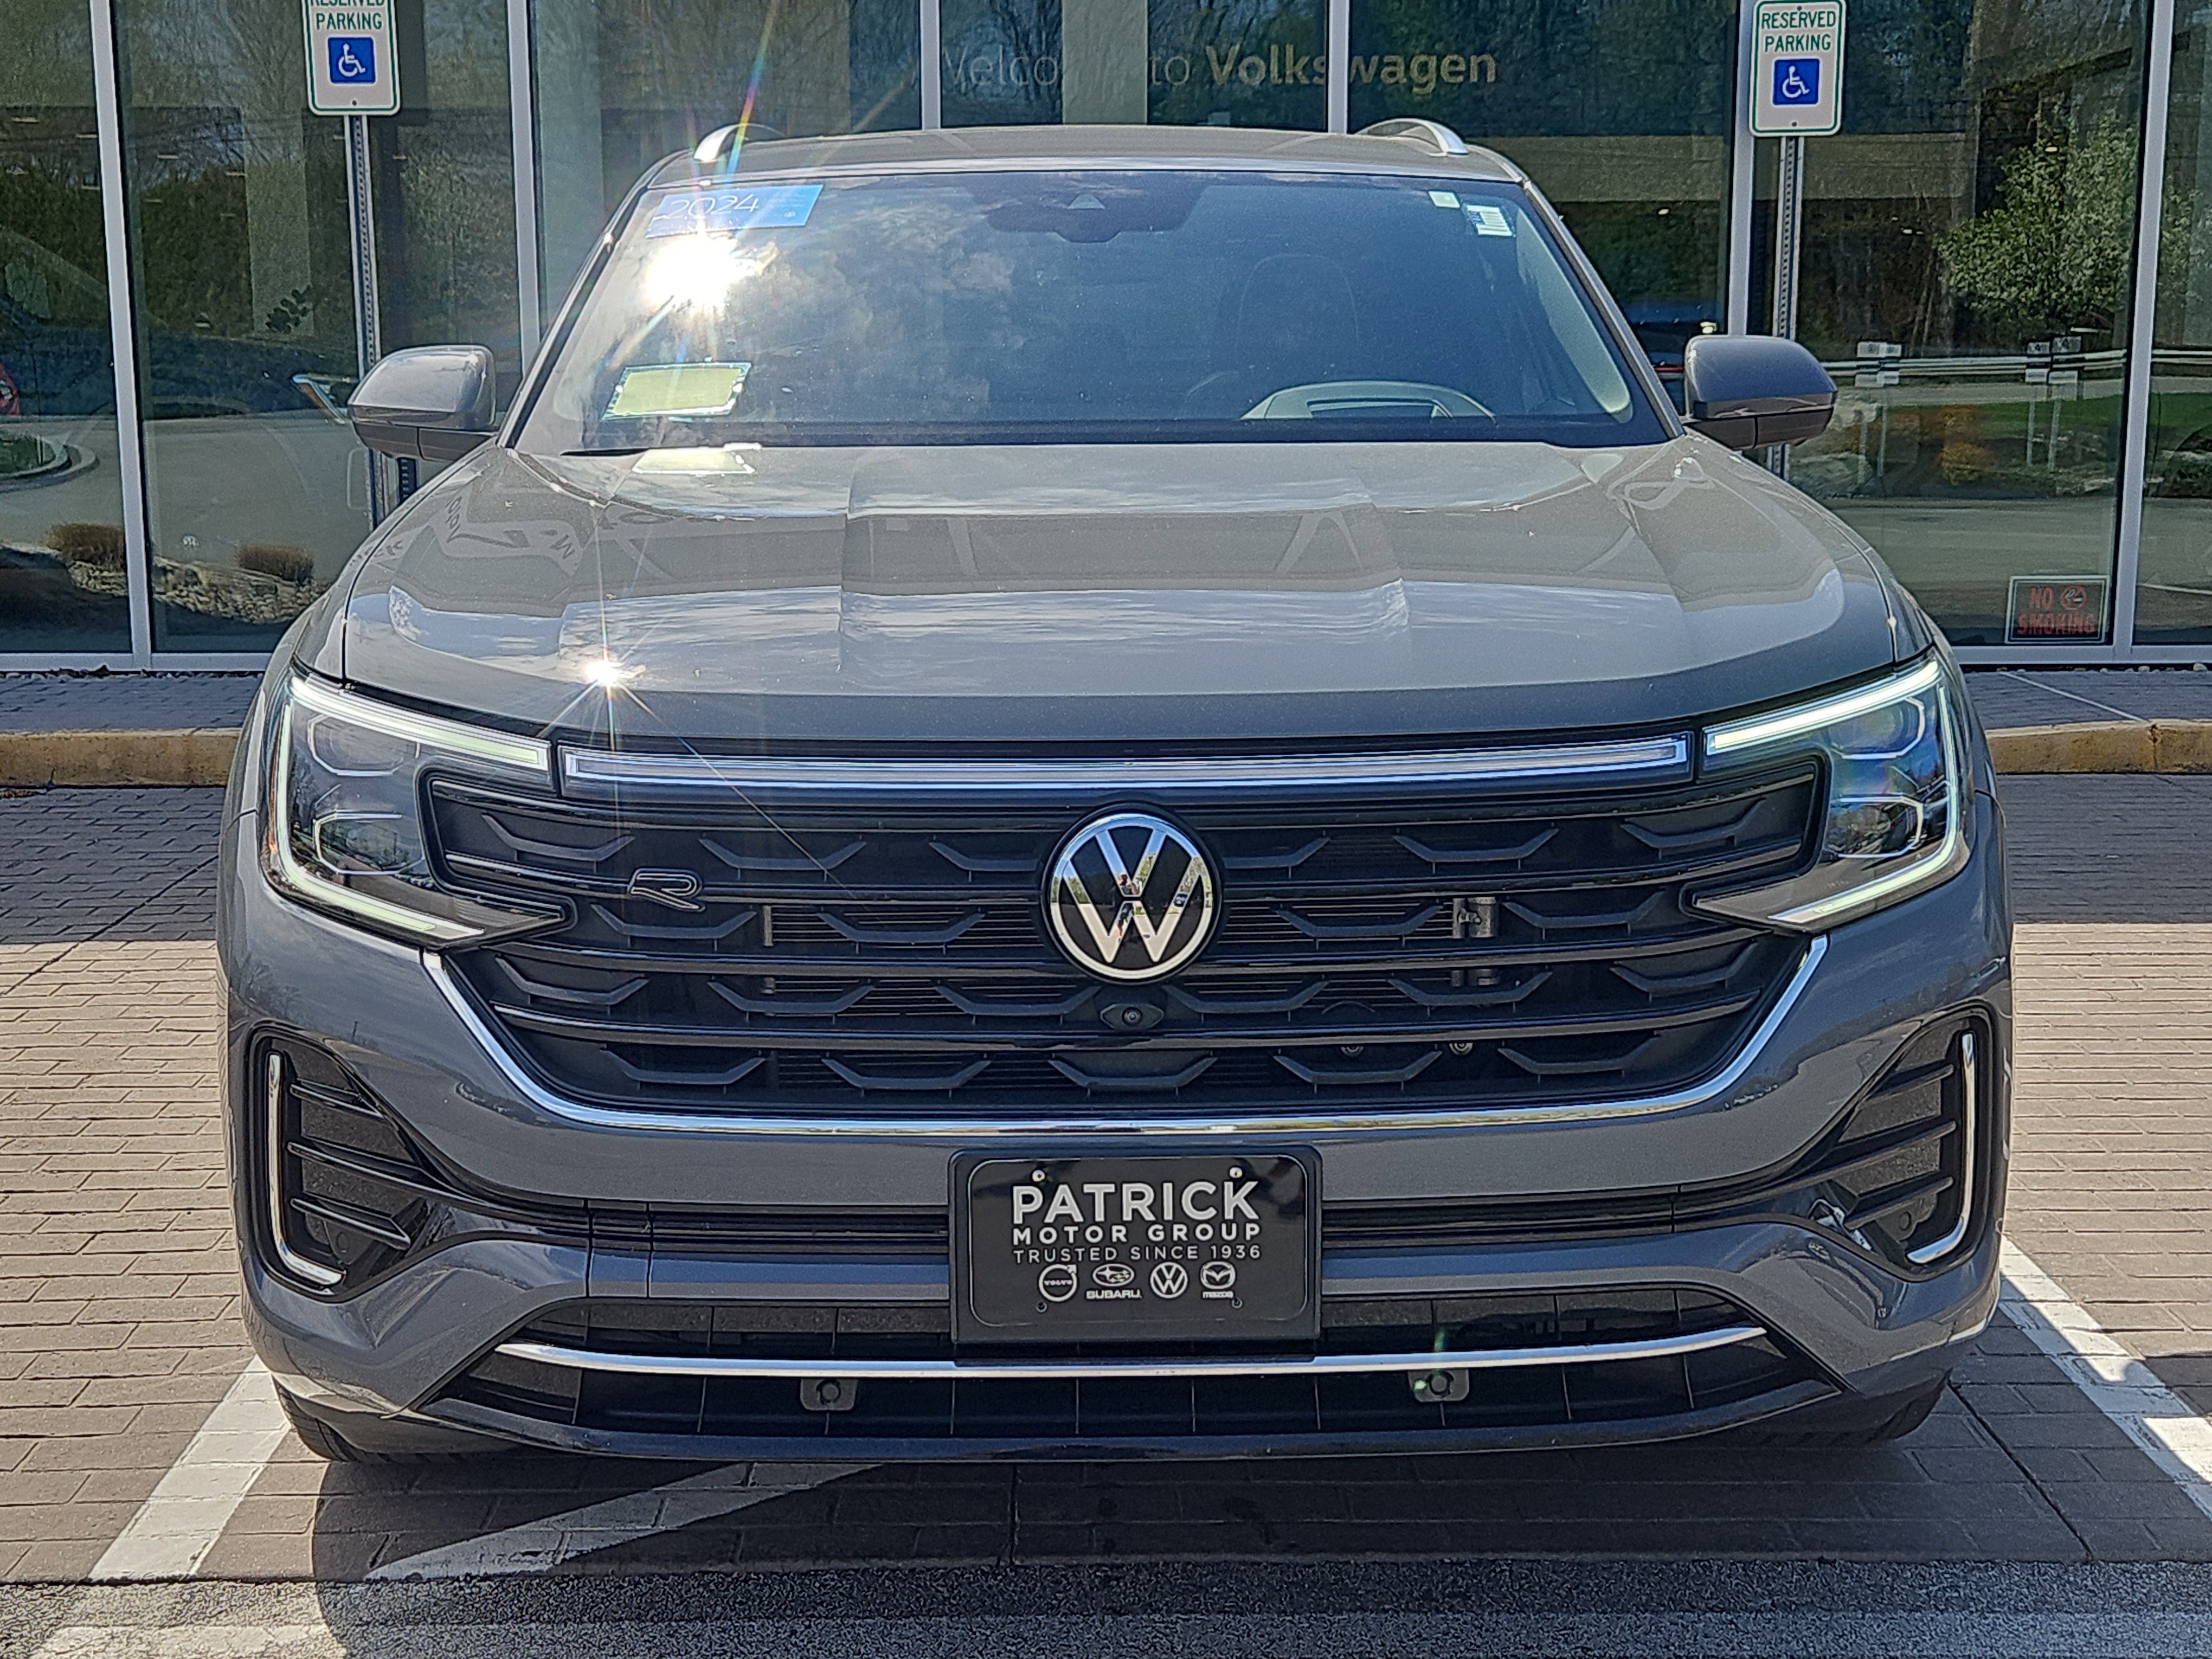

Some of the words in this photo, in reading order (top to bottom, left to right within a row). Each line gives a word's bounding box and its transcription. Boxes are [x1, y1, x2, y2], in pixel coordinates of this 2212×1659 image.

[316, 12, 382, 30] PARKING
[1761, 11, 1836, 29] RESERVED
[1765, 33, 1831, 52] PARKING
[1149, 52, 1189, 85] to
[653, 193, 758, 219] 2024
[2029, 587, 2054, 609] NO
[2017, 613, 2097, 635] SMOKING
[1013, 1181, 1259, 1224] PATRICK
[1013, 1225, 1128, 1245] MOTOR
[1147, 1223, 1260, 1242] GROUP
[1013, 1247, 1117, 1264] TRUSTED
[1130, 1245, 1198, 1260] SINCE
[1210, 1245, 1261, 1259] 1936
[1086, 1289, 1141, 1300] SUBARU
